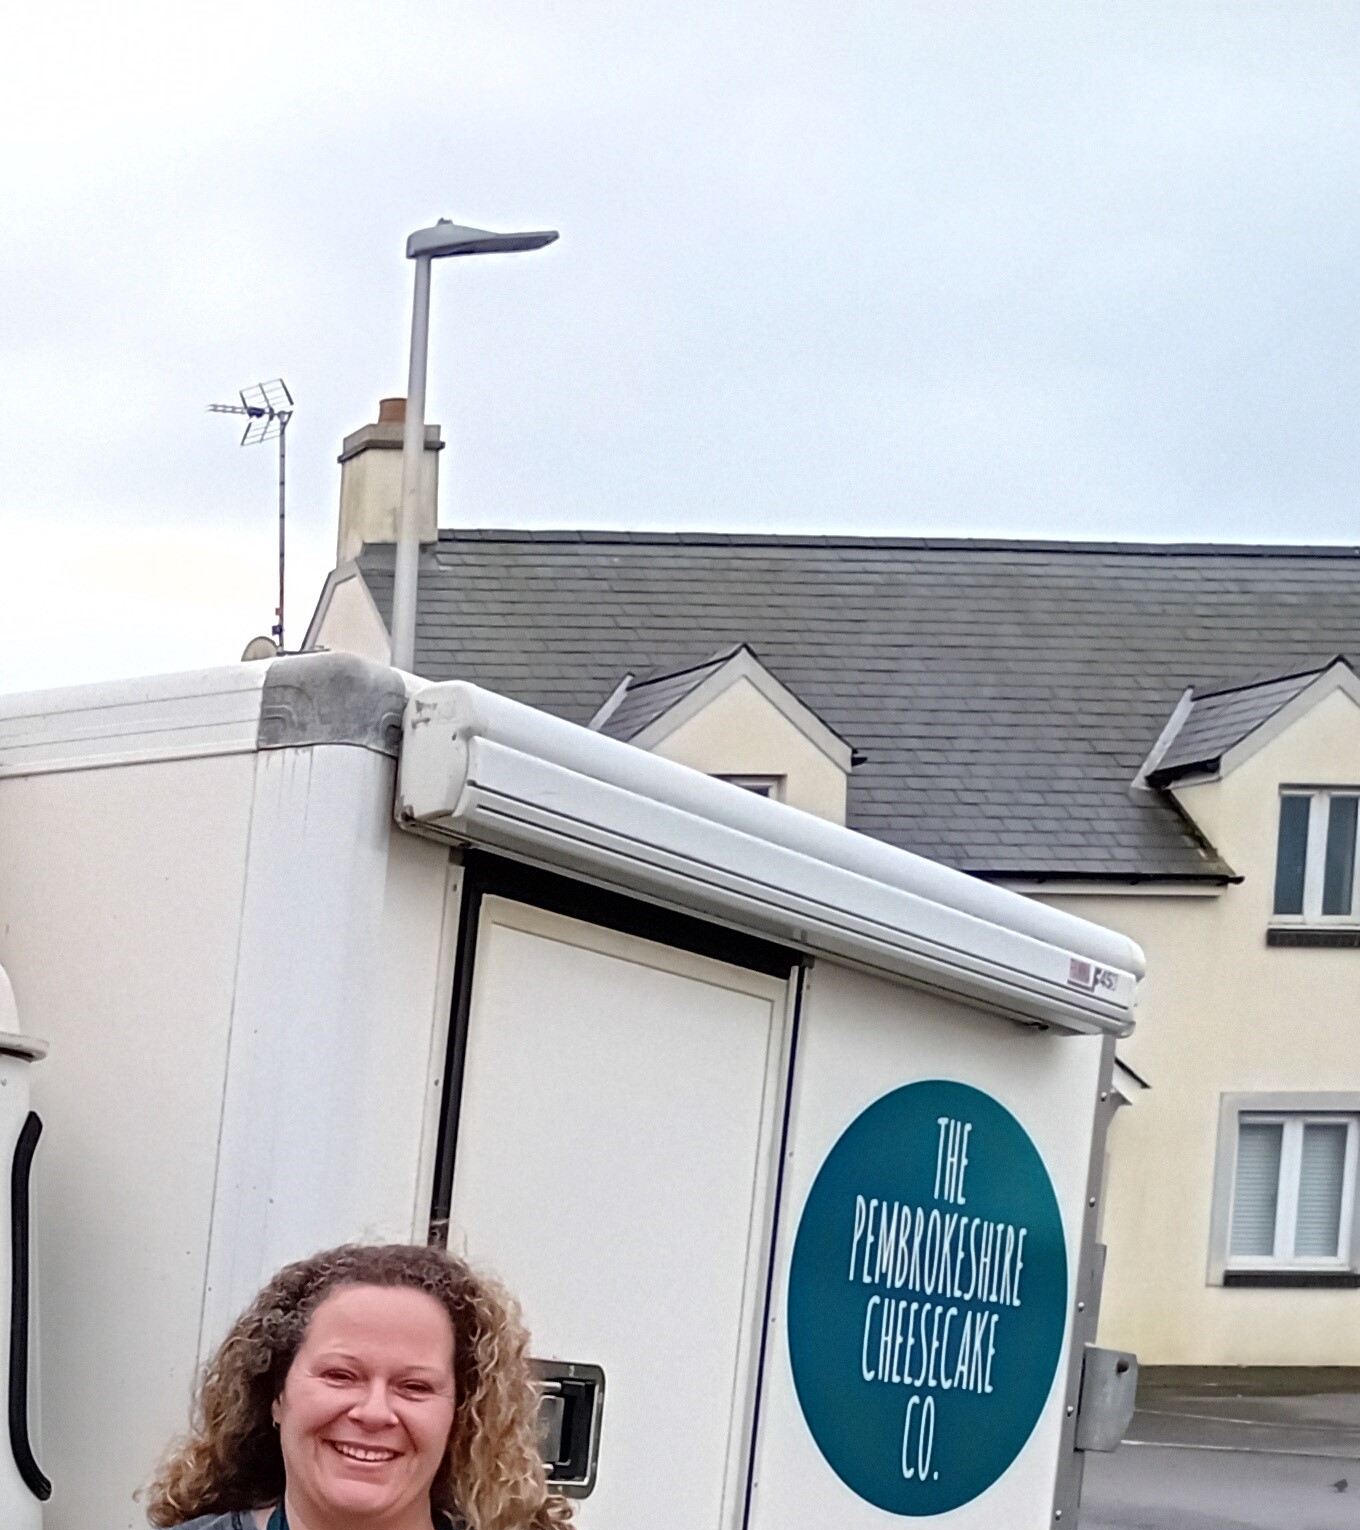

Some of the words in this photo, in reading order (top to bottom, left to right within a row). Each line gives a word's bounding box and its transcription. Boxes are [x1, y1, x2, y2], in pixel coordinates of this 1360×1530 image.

[933, 1116, 972, 1205] THE
[848, 1194, 1027, 1306] PEMBROKESHIRE
[862, 1295, 999, 1393] CHEESECAKE
[901, 1395, 939, 1481] CO.
